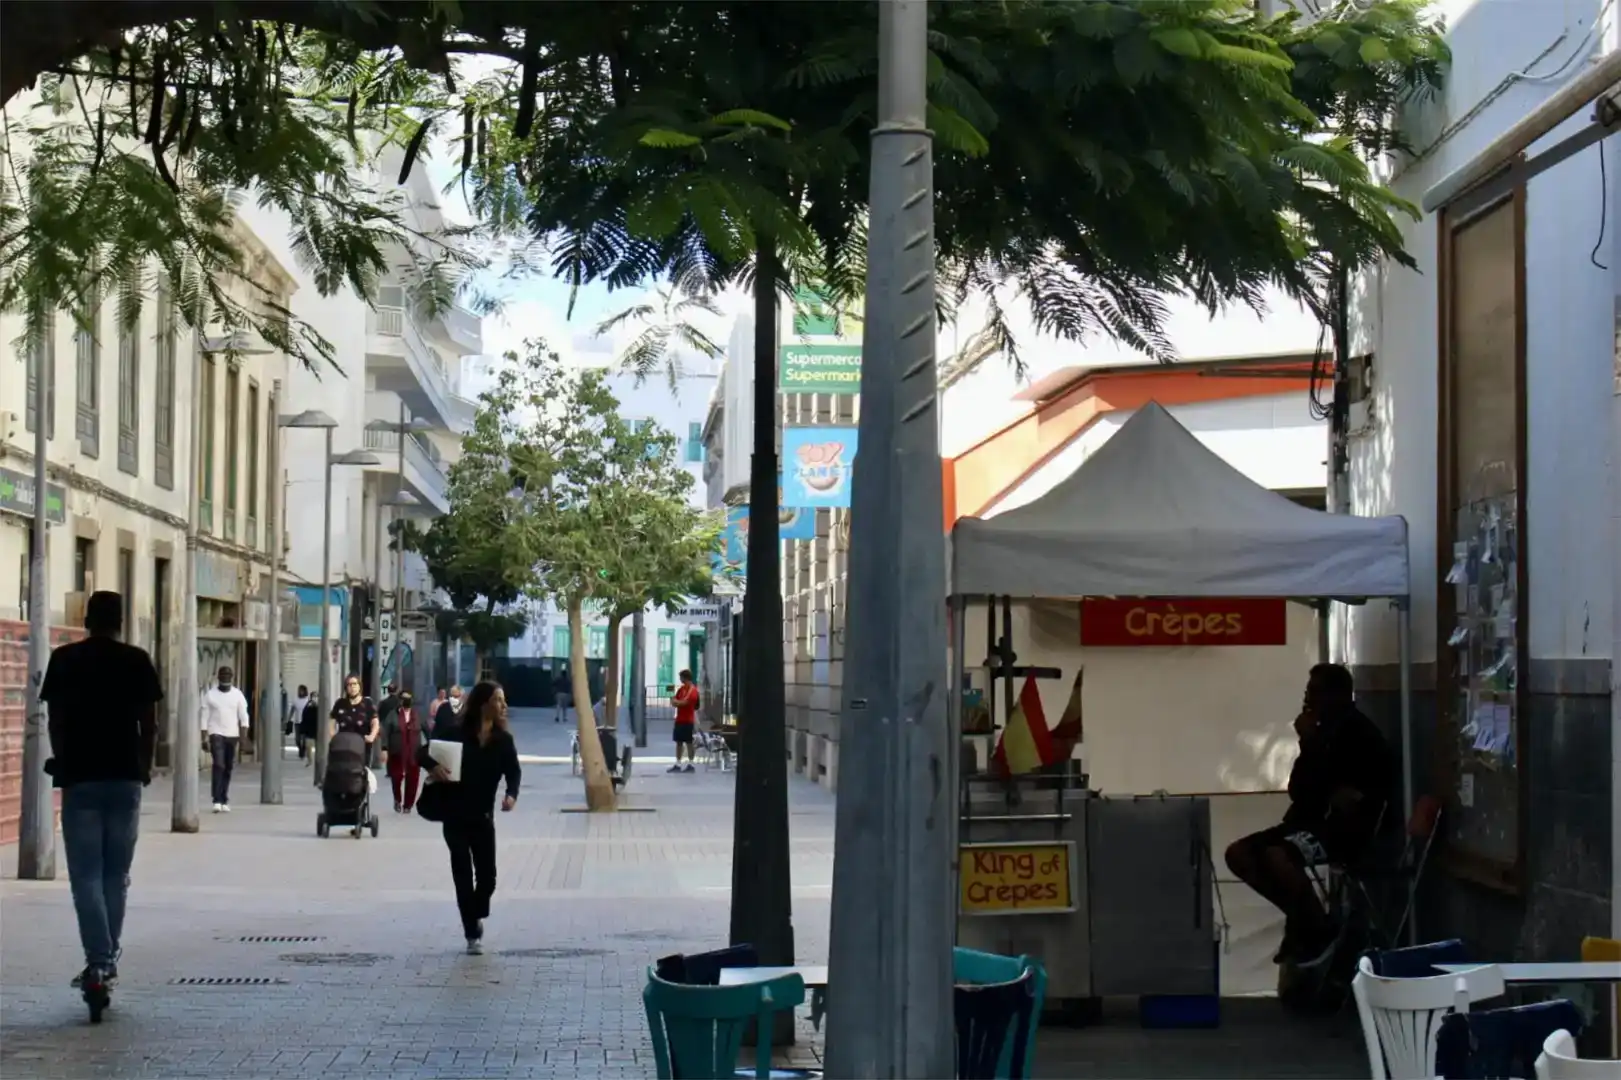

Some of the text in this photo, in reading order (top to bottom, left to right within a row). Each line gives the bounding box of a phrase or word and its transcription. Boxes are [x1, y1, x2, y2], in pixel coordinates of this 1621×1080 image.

[689, 609, 718, 617] SMITH
[1125, 603, 1242, 643] Crèpes
[381, 619, 390, 695] OUTLT
[973, 851, 1061, 880] King of
[968, 877, 1058, 908] Crèpes
